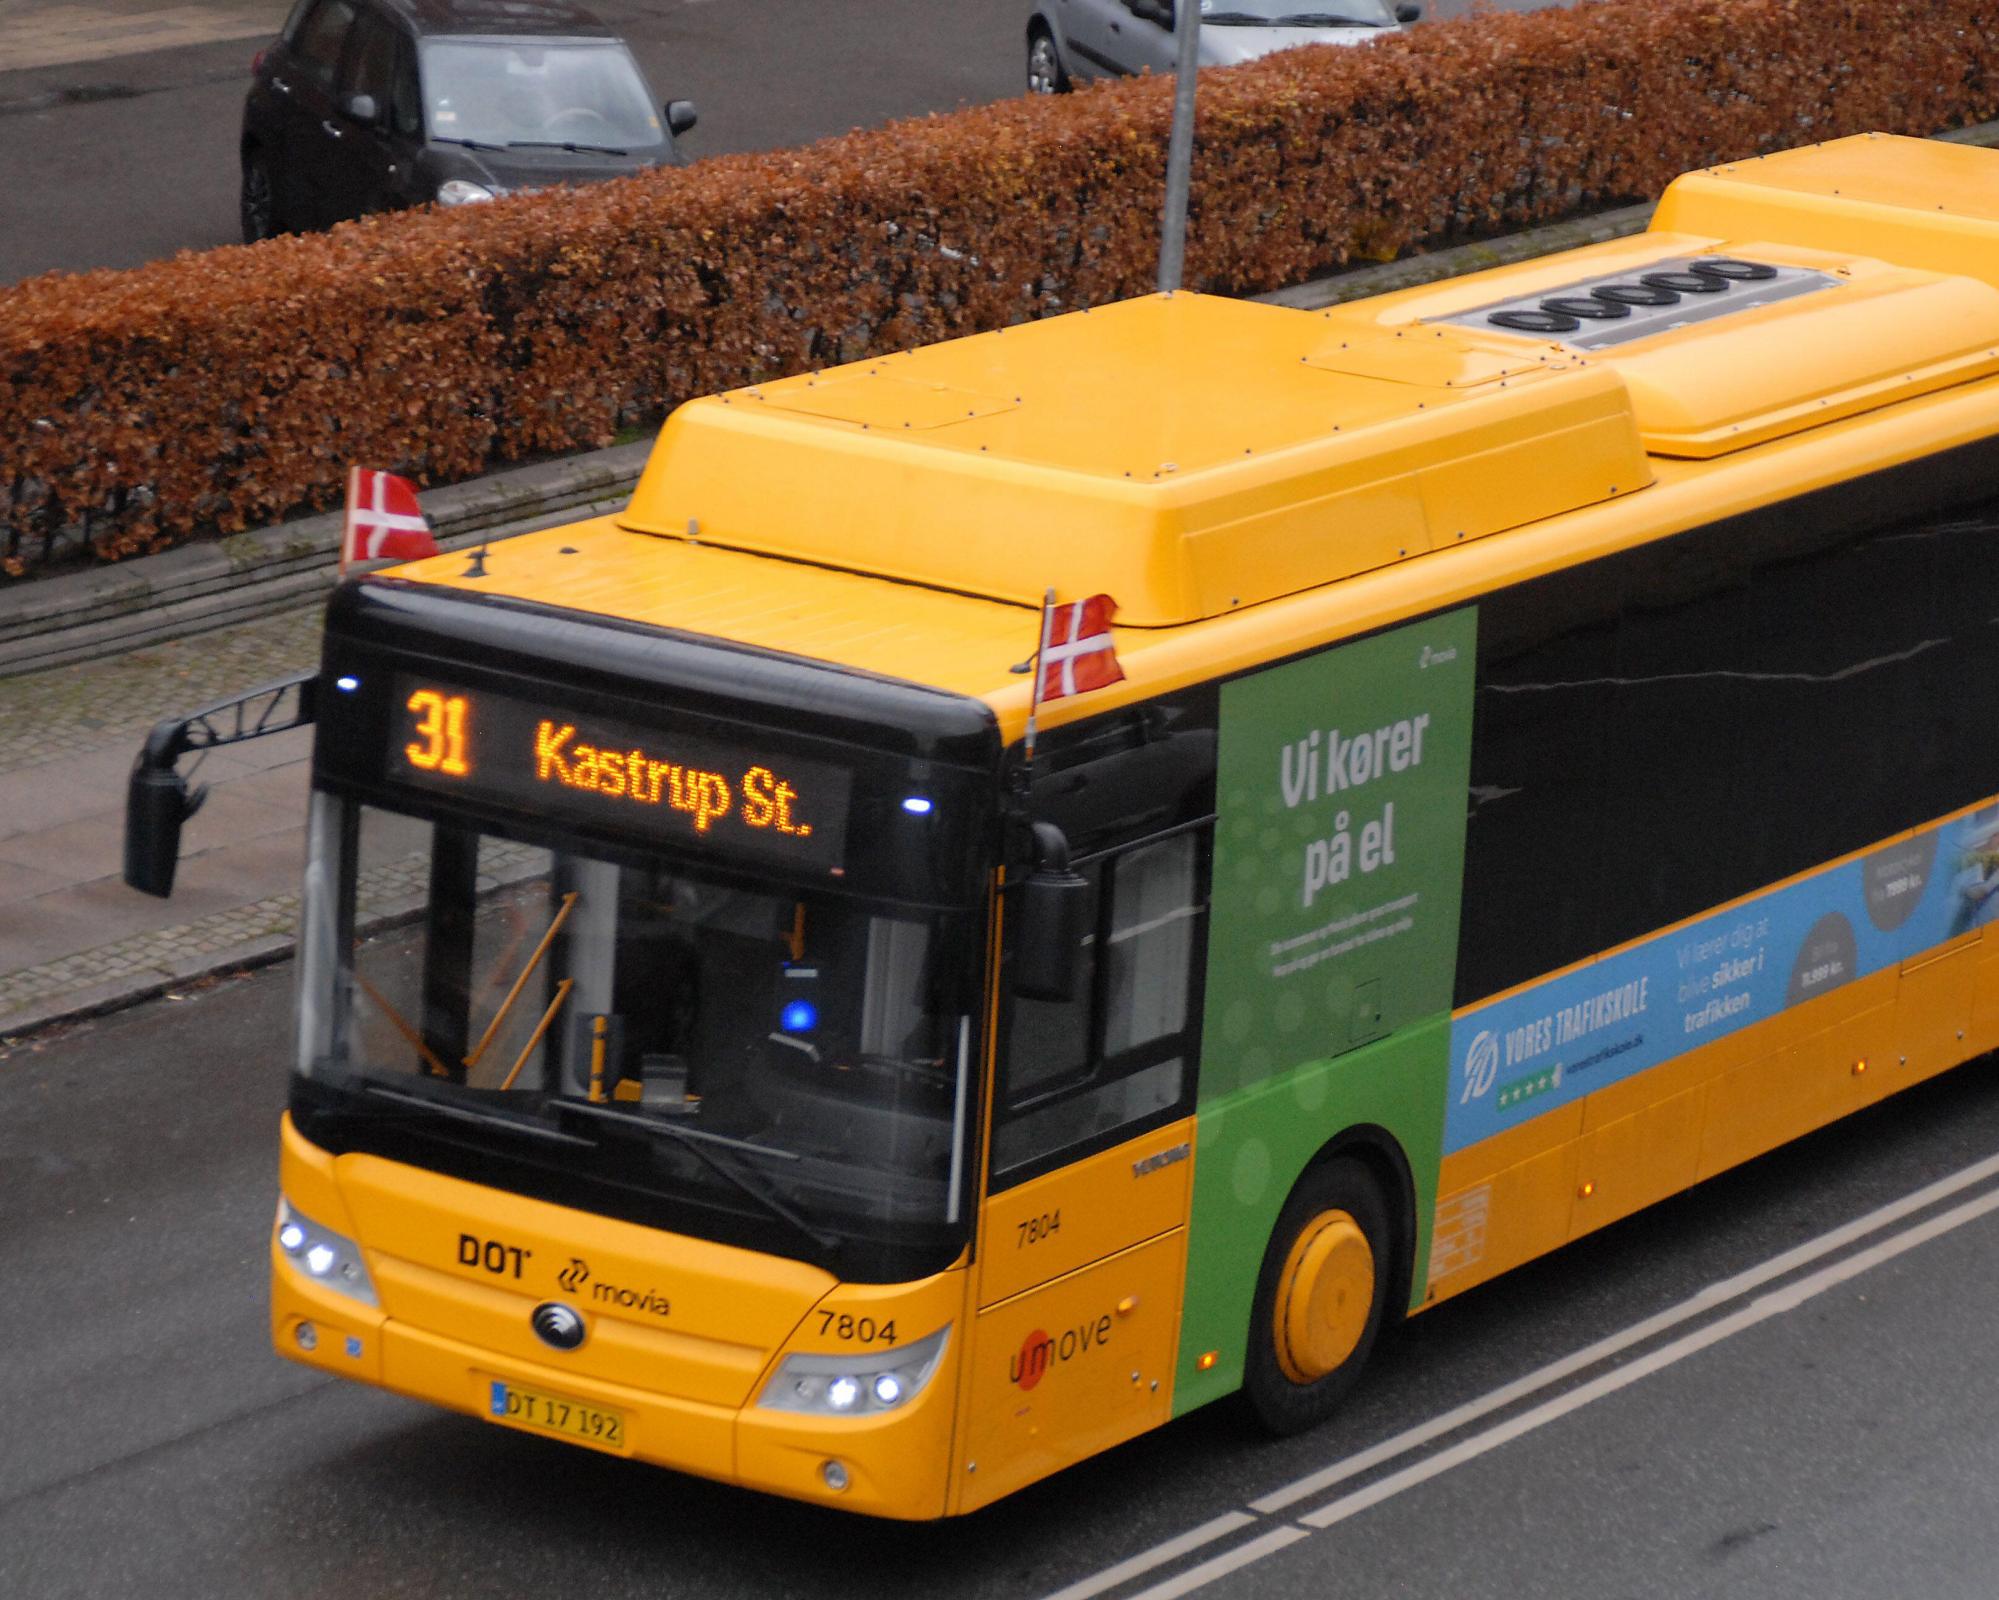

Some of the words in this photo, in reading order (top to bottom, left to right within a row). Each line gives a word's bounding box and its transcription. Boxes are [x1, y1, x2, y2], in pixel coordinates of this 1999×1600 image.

[405, 688, 469, 778] 31
[533, 719, 731, 833] Kastrup
[742, 765, 813, 837] St.
[1280, 729, 1320, 808] Vi
[1326, 713, 1430, 795] kører
[1303, 810, 1351, 907] på
[1359, 802, 1395, 873] el
[1712, 957, 1757, 989] sikker
[1757, 947, 1765, 971] i
[1505, 1016, 1553, 1066] VORES
[1556, 976, 1649, 1045] TRAFIKSKOLE
[1684, 992, 1751, 1033] trafikken
[1017, 1208, 1061, 1249] 7804
[458, 1233, 531, 1280] DOT
[593, 1277, 671, 1317] movia
[818, 1310, 898, 1345] 7804
[1009, 1314, 1112, 1385] umove
[507, 1391, 536, 1419] DT
[545, 1401, 571, 1428] 17
[580, 1410, 618, 1441] 192
